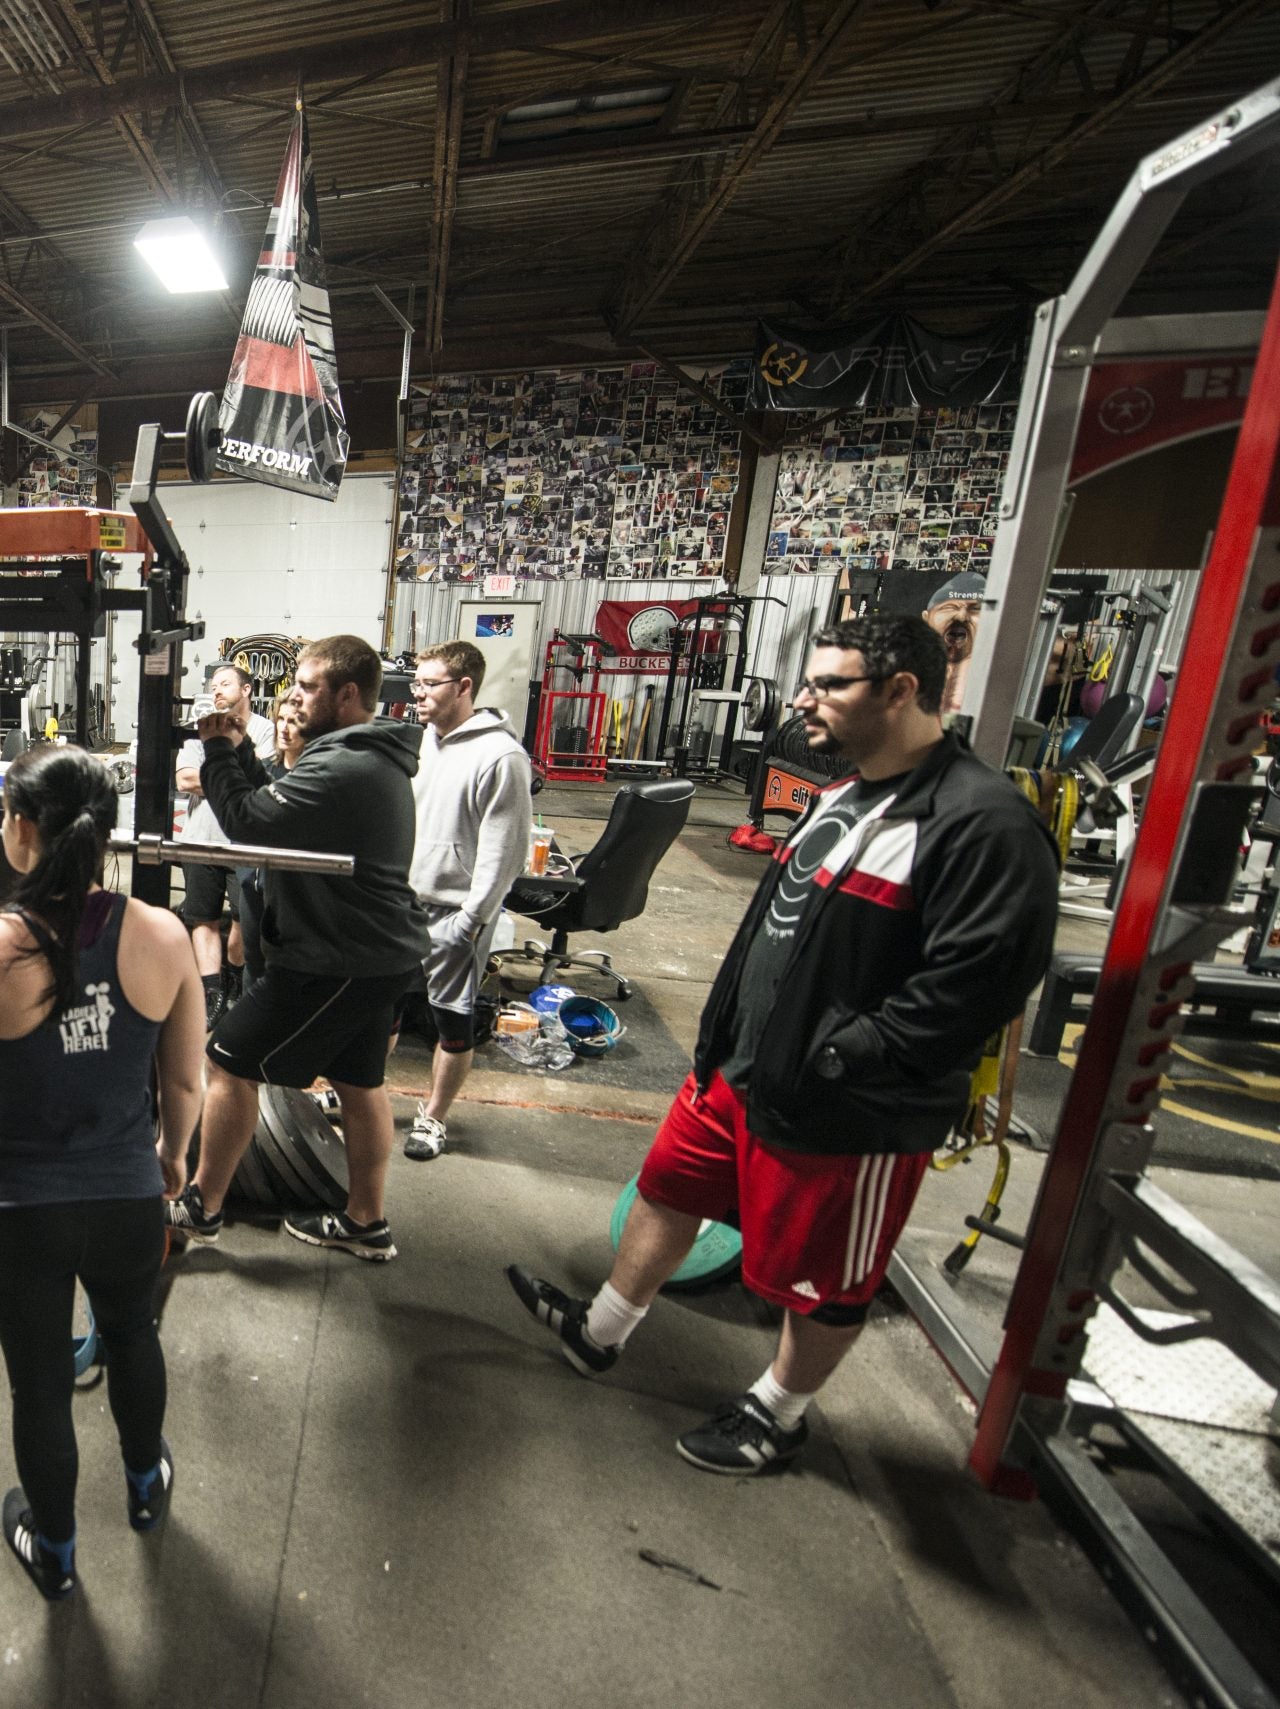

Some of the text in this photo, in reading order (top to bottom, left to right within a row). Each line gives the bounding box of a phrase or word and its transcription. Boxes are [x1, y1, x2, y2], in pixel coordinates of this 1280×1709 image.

[491, 577, 511, 591] EXIT
[62, 1004, 97, 1022] LADIES
[59, 1016, 98, 1038] LIFT
